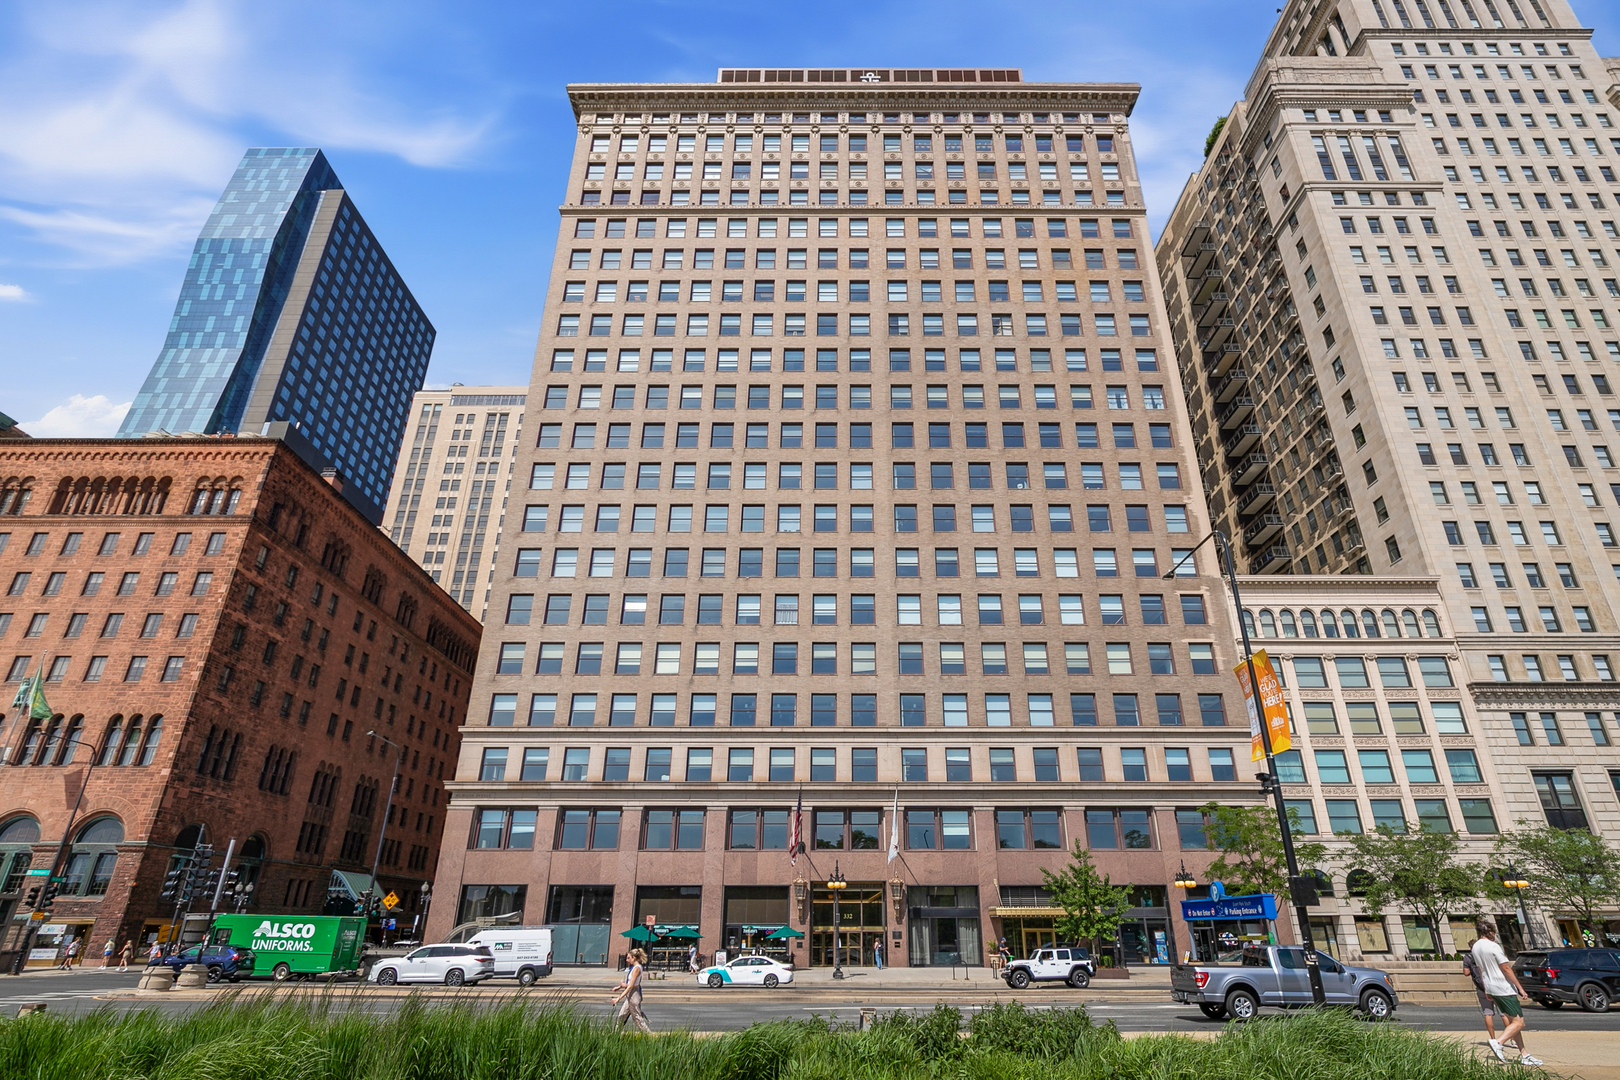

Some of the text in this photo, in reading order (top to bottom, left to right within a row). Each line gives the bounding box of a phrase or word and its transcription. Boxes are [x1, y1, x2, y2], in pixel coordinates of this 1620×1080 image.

[1260, 673, 1272, 683] WE'RE
[1259, 679, 1277, 693] GLAD
[1262, 687, 1278, 698] YOU'RE
[1263, 692, 1283, 709] HERE!
[253, 920, 316, 939] ALSCO
